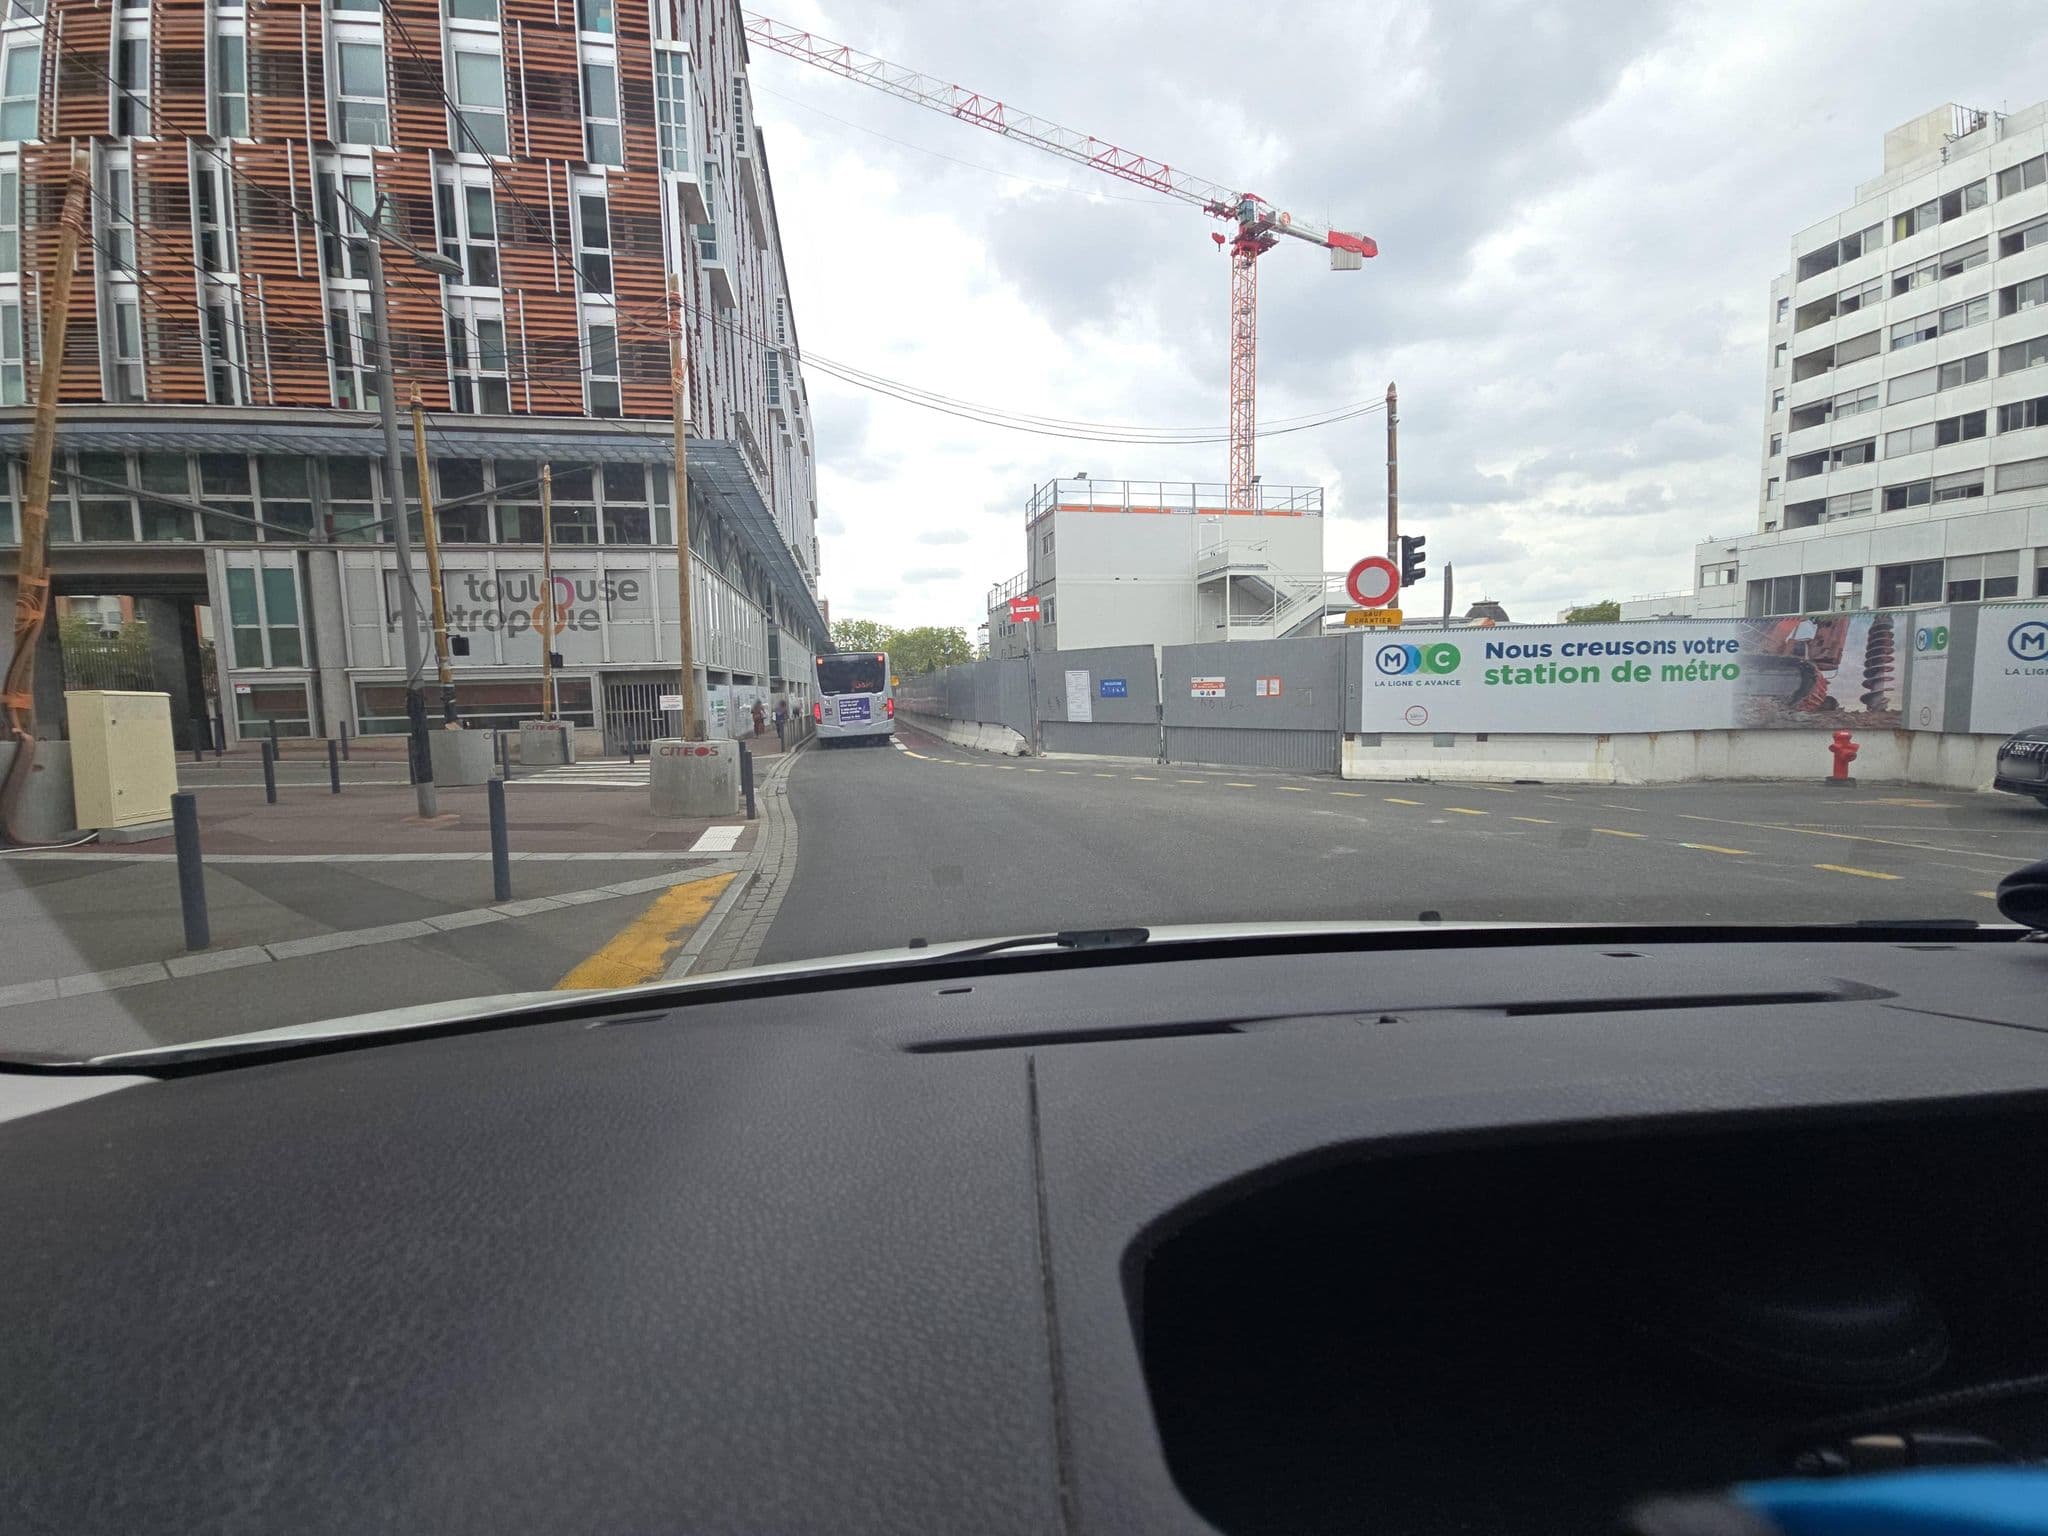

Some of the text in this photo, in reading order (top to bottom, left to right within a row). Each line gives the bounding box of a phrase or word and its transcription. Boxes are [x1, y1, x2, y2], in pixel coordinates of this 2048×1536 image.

[464, 573, 639, 606] toulouse
[1485, 637, 1740, 659] Nous creusons votre
[2020, 632, 2045, 651] M
[1384, 651, 1450, 667] M C
[1484, 658, 1741, 686] station de métro
[2004, 668, 2020, 676] LA
